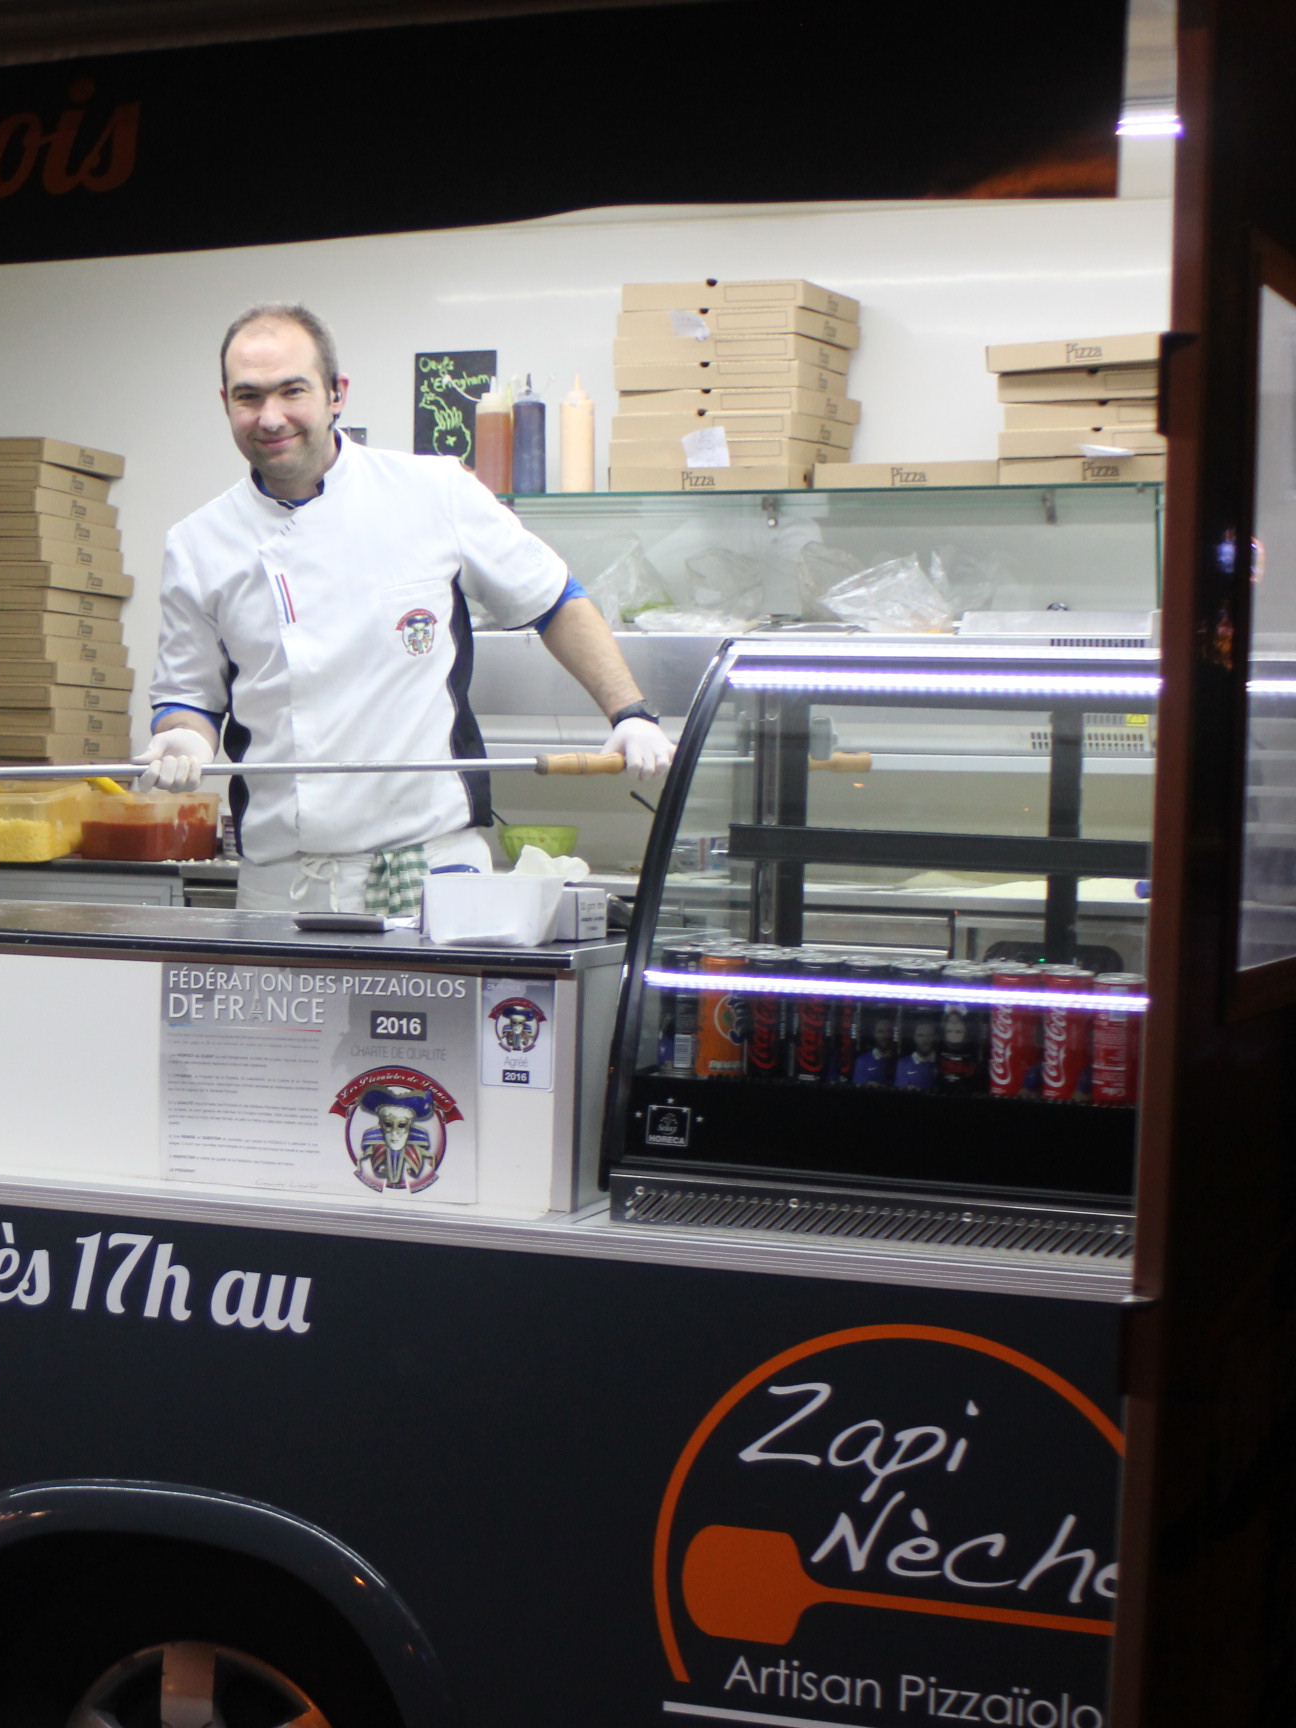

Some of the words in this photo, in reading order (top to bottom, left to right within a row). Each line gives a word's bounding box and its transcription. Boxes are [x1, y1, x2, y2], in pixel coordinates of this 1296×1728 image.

[1066, 343, 1103, 363] Pizza
[681, 471, 716, 490] Pizza
[891, 467, 927, 486] Pizza
[1082, 461, 1120, 481] Pizza
[169, 967, 292, 994] FÉDÉRATION
[300, 974, 336, 994] DES
[343, 975, 467, 999] PIZZAÏOLOS
[169, 993, 204, 1019] DE
[214, 994, 326, 1024] FRANCE
[376, 1017, 422, 1035] 2016
[351, 1045, 388, 1059] CHARTE
[391, 1047, 405, 1059] DE
[504, 1072, 528, 1081] 2016
[648, 1134, 685, 1144] HORECA
[70, 1230, 193, 1323] 17h
[208, 1266, 315, 1335] au
[738, 1382, 981, 1503] Zapi
[724, 1654, 882, 1708] Artisan
[899, 1674, 1103, 1728] Pizzaïolo
